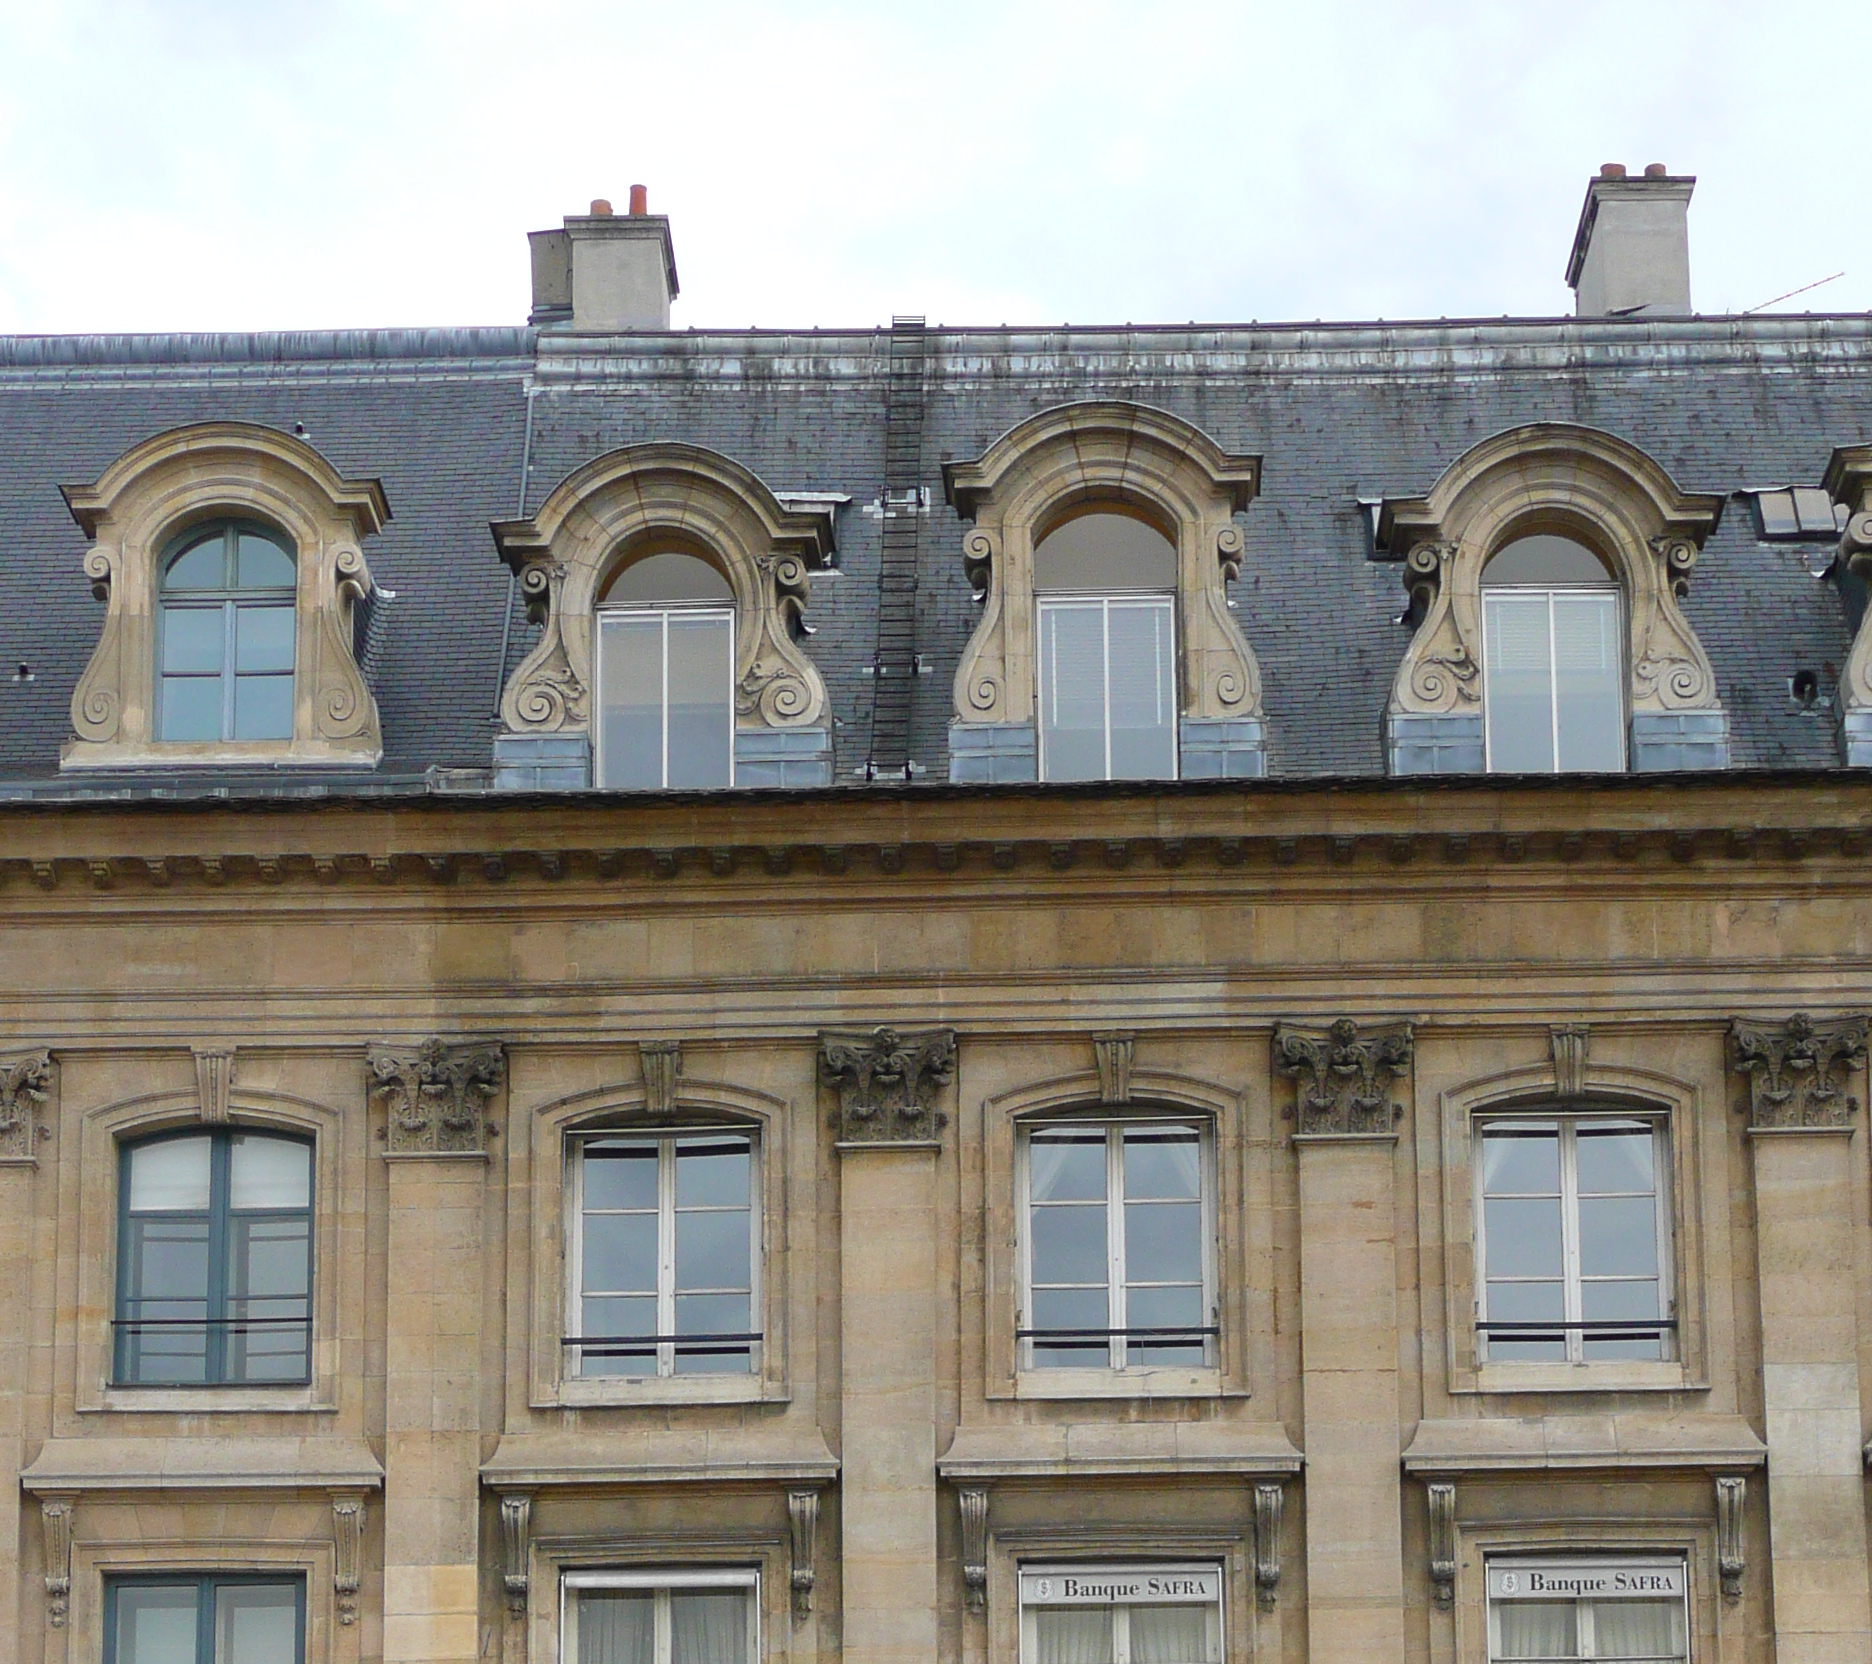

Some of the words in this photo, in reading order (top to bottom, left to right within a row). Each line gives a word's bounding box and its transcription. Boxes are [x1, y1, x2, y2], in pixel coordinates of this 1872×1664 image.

[1064, 1579, 1140, 1601] Banque
[1148, 1578, 1207, 1595] SAFRA
[1530, 1573, 1607, 1595] Banque
[1615, 1572, 1674, 1591] SAFRA
